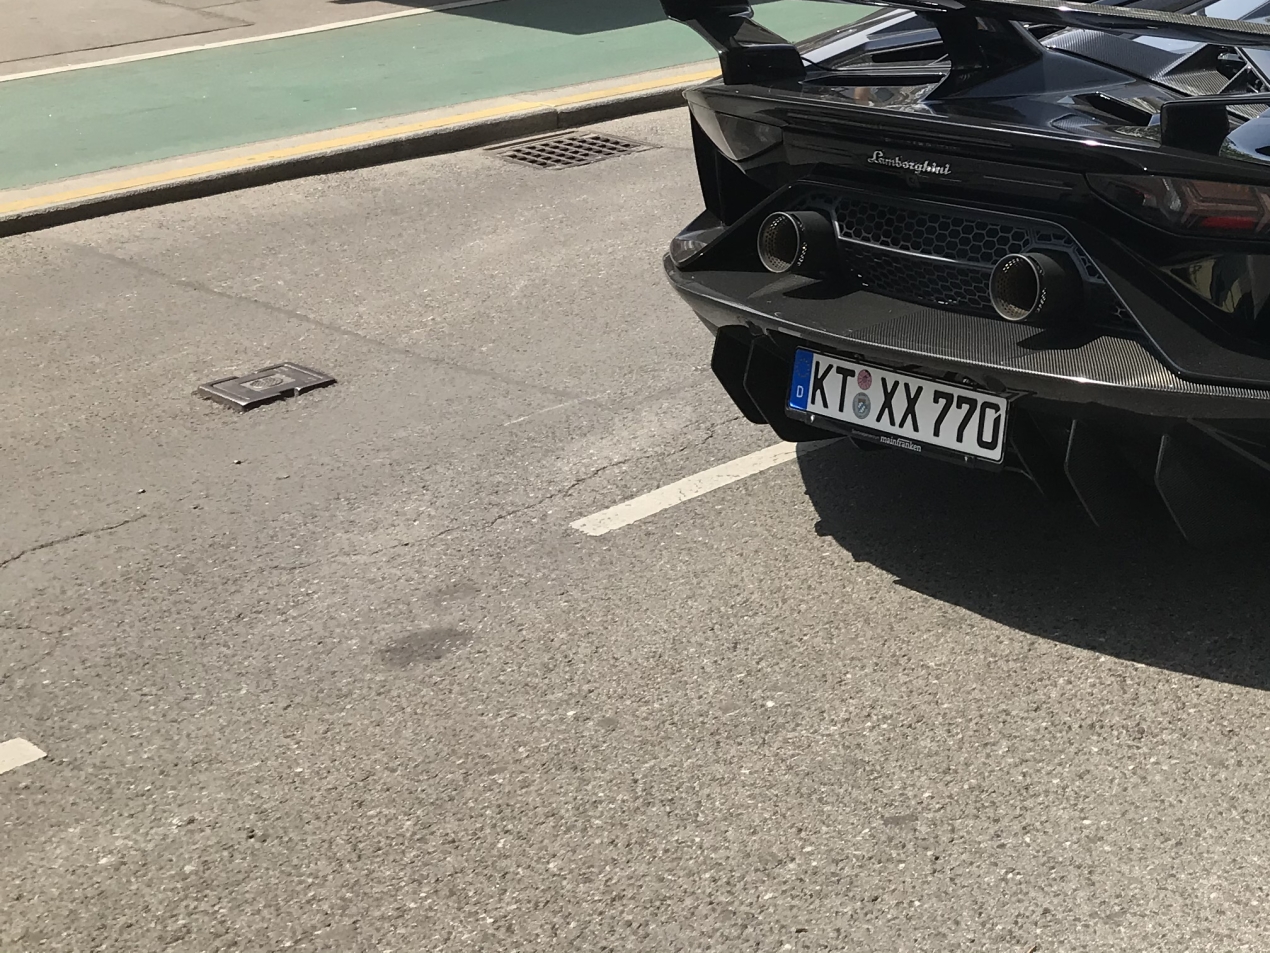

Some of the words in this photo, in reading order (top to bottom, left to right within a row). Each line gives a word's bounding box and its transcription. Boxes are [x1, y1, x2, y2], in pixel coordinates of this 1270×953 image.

[867, 150, 952, 175] Lamborghini
[796, 385, 804, 398] D
[810, 360, 856, 413] KT
[875, 376, 924, 433] XX
[932, 389, 1001, 451] 770
[880, 435, 922, 452] mainfranken
